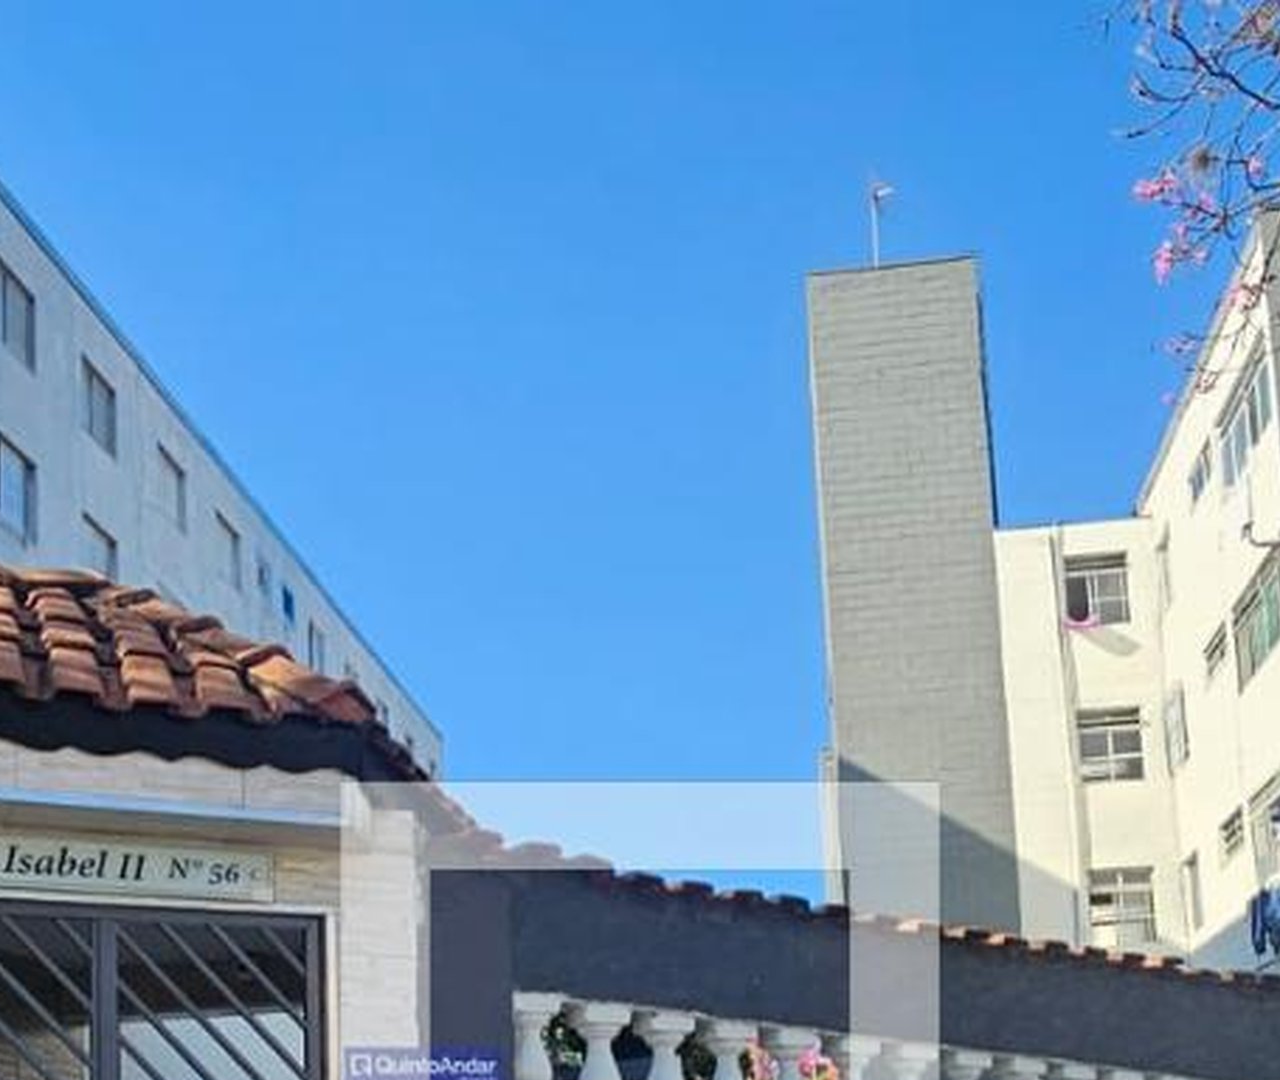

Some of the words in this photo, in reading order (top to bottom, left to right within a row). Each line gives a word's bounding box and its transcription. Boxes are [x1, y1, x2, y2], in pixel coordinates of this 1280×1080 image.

[2, 844, 110, 880] Isabel
[118, 852, 146, 882] II
[208, 862, 241, 884] 56
[374, 1055, 499, 1075] QuintoAndar
